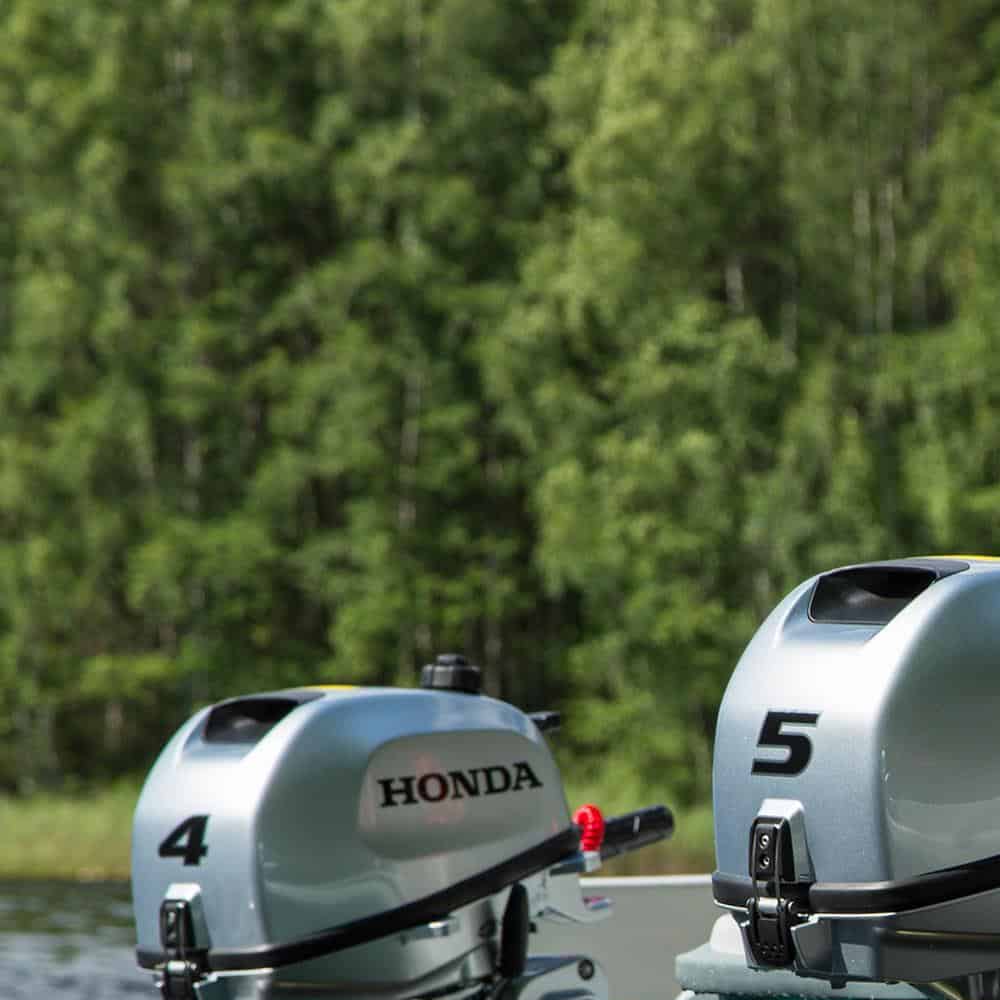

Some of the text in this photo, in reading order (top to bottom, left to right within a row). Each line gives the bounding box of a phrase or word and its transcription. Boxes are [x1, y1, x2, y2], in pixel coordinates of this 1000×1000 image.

[751, 710, 820, 777] 5
[377, 760, 543, 808] HONDA
[157, 814, 210, 866] 4
